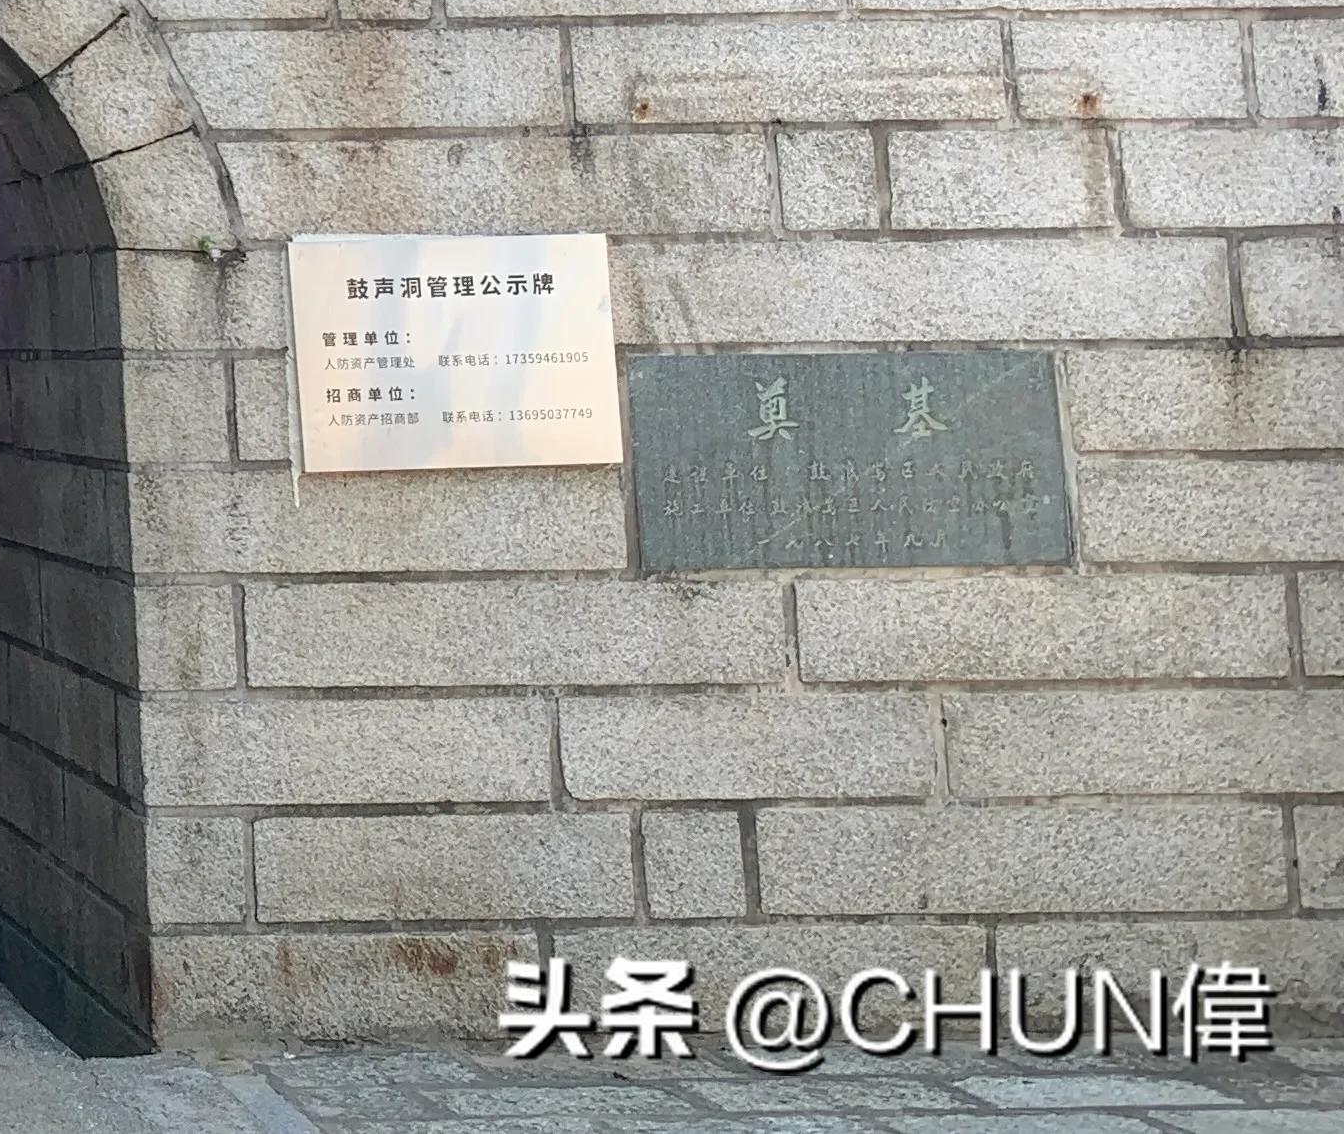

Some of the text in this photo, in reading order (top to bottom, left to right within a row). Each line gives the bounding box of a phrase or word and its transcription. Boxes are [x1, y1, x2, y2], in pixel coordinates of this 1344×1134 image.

[346, 273, 555, 300] 鼓声洞管理公示牌
[324, 355, 416, 370] 人防资产管理处
[328, 412, 420, 427] 人防资产招商部
